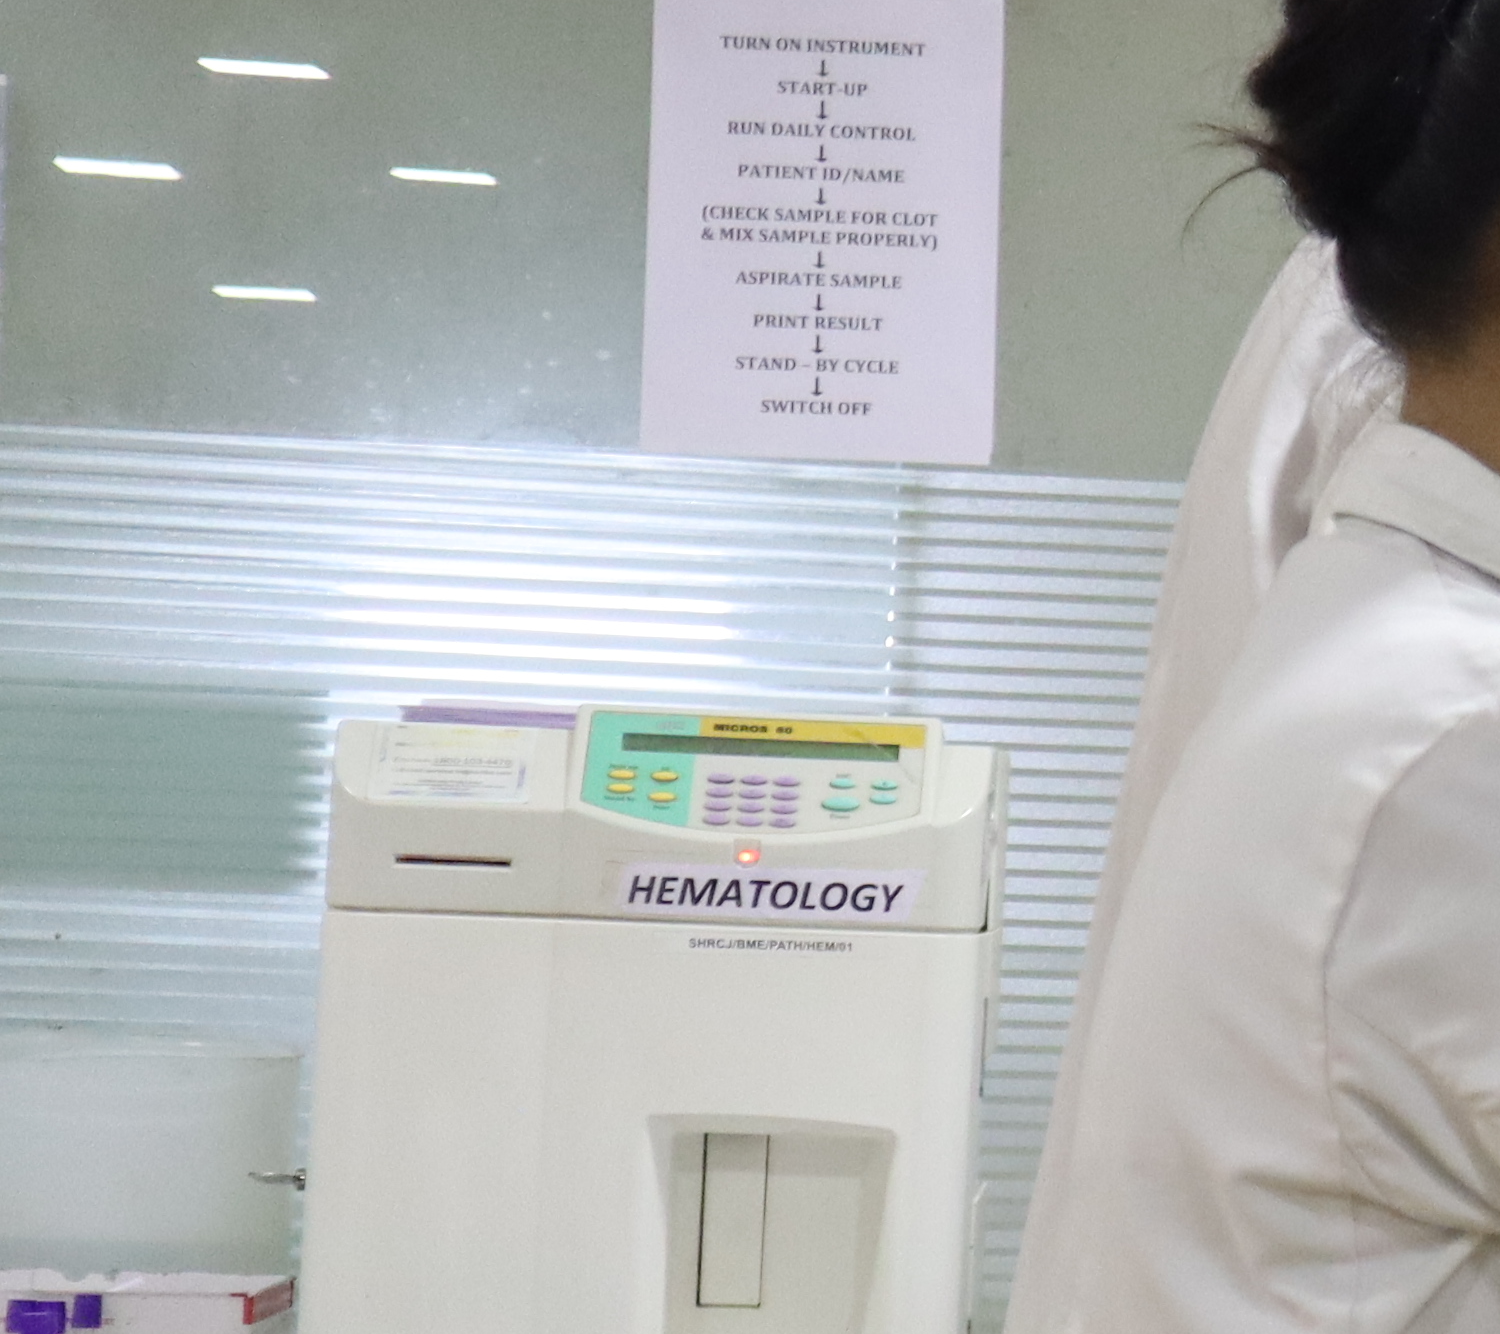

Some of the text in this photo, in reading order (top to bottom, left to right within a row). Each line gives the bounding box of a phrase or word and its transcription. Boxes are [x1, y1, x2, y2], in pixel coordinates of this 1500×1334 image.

[720, 35, 925, 57] TURN ON INSTRUMENT
[777, 81, 868, 96] START-UP
[727, 121, 916, 141] RUN DAILY CONTROL
[738, 164, 904, 184] PATIENT ID/NAME
[701, 206, 938, 227] (CHECK SAMPLE FOR CLOT
[701, 228, 938, 251] & MIX SAMPLE PROPERLY)
[736, 271, 902, 290] ASPIRATE SAMPLE
[753, 315, 883, 332] PRINT RESULT
[735, 357, 796, 371] STAND
[816, 359, 839, 373] BY
[844, 359, 899, 375] CYCLE
[761, 400, 873, 416] SWITCH OFF
[713, 723, 768, 734] MICROS
[628, 875, 904, 912] HEMATOLOGY
